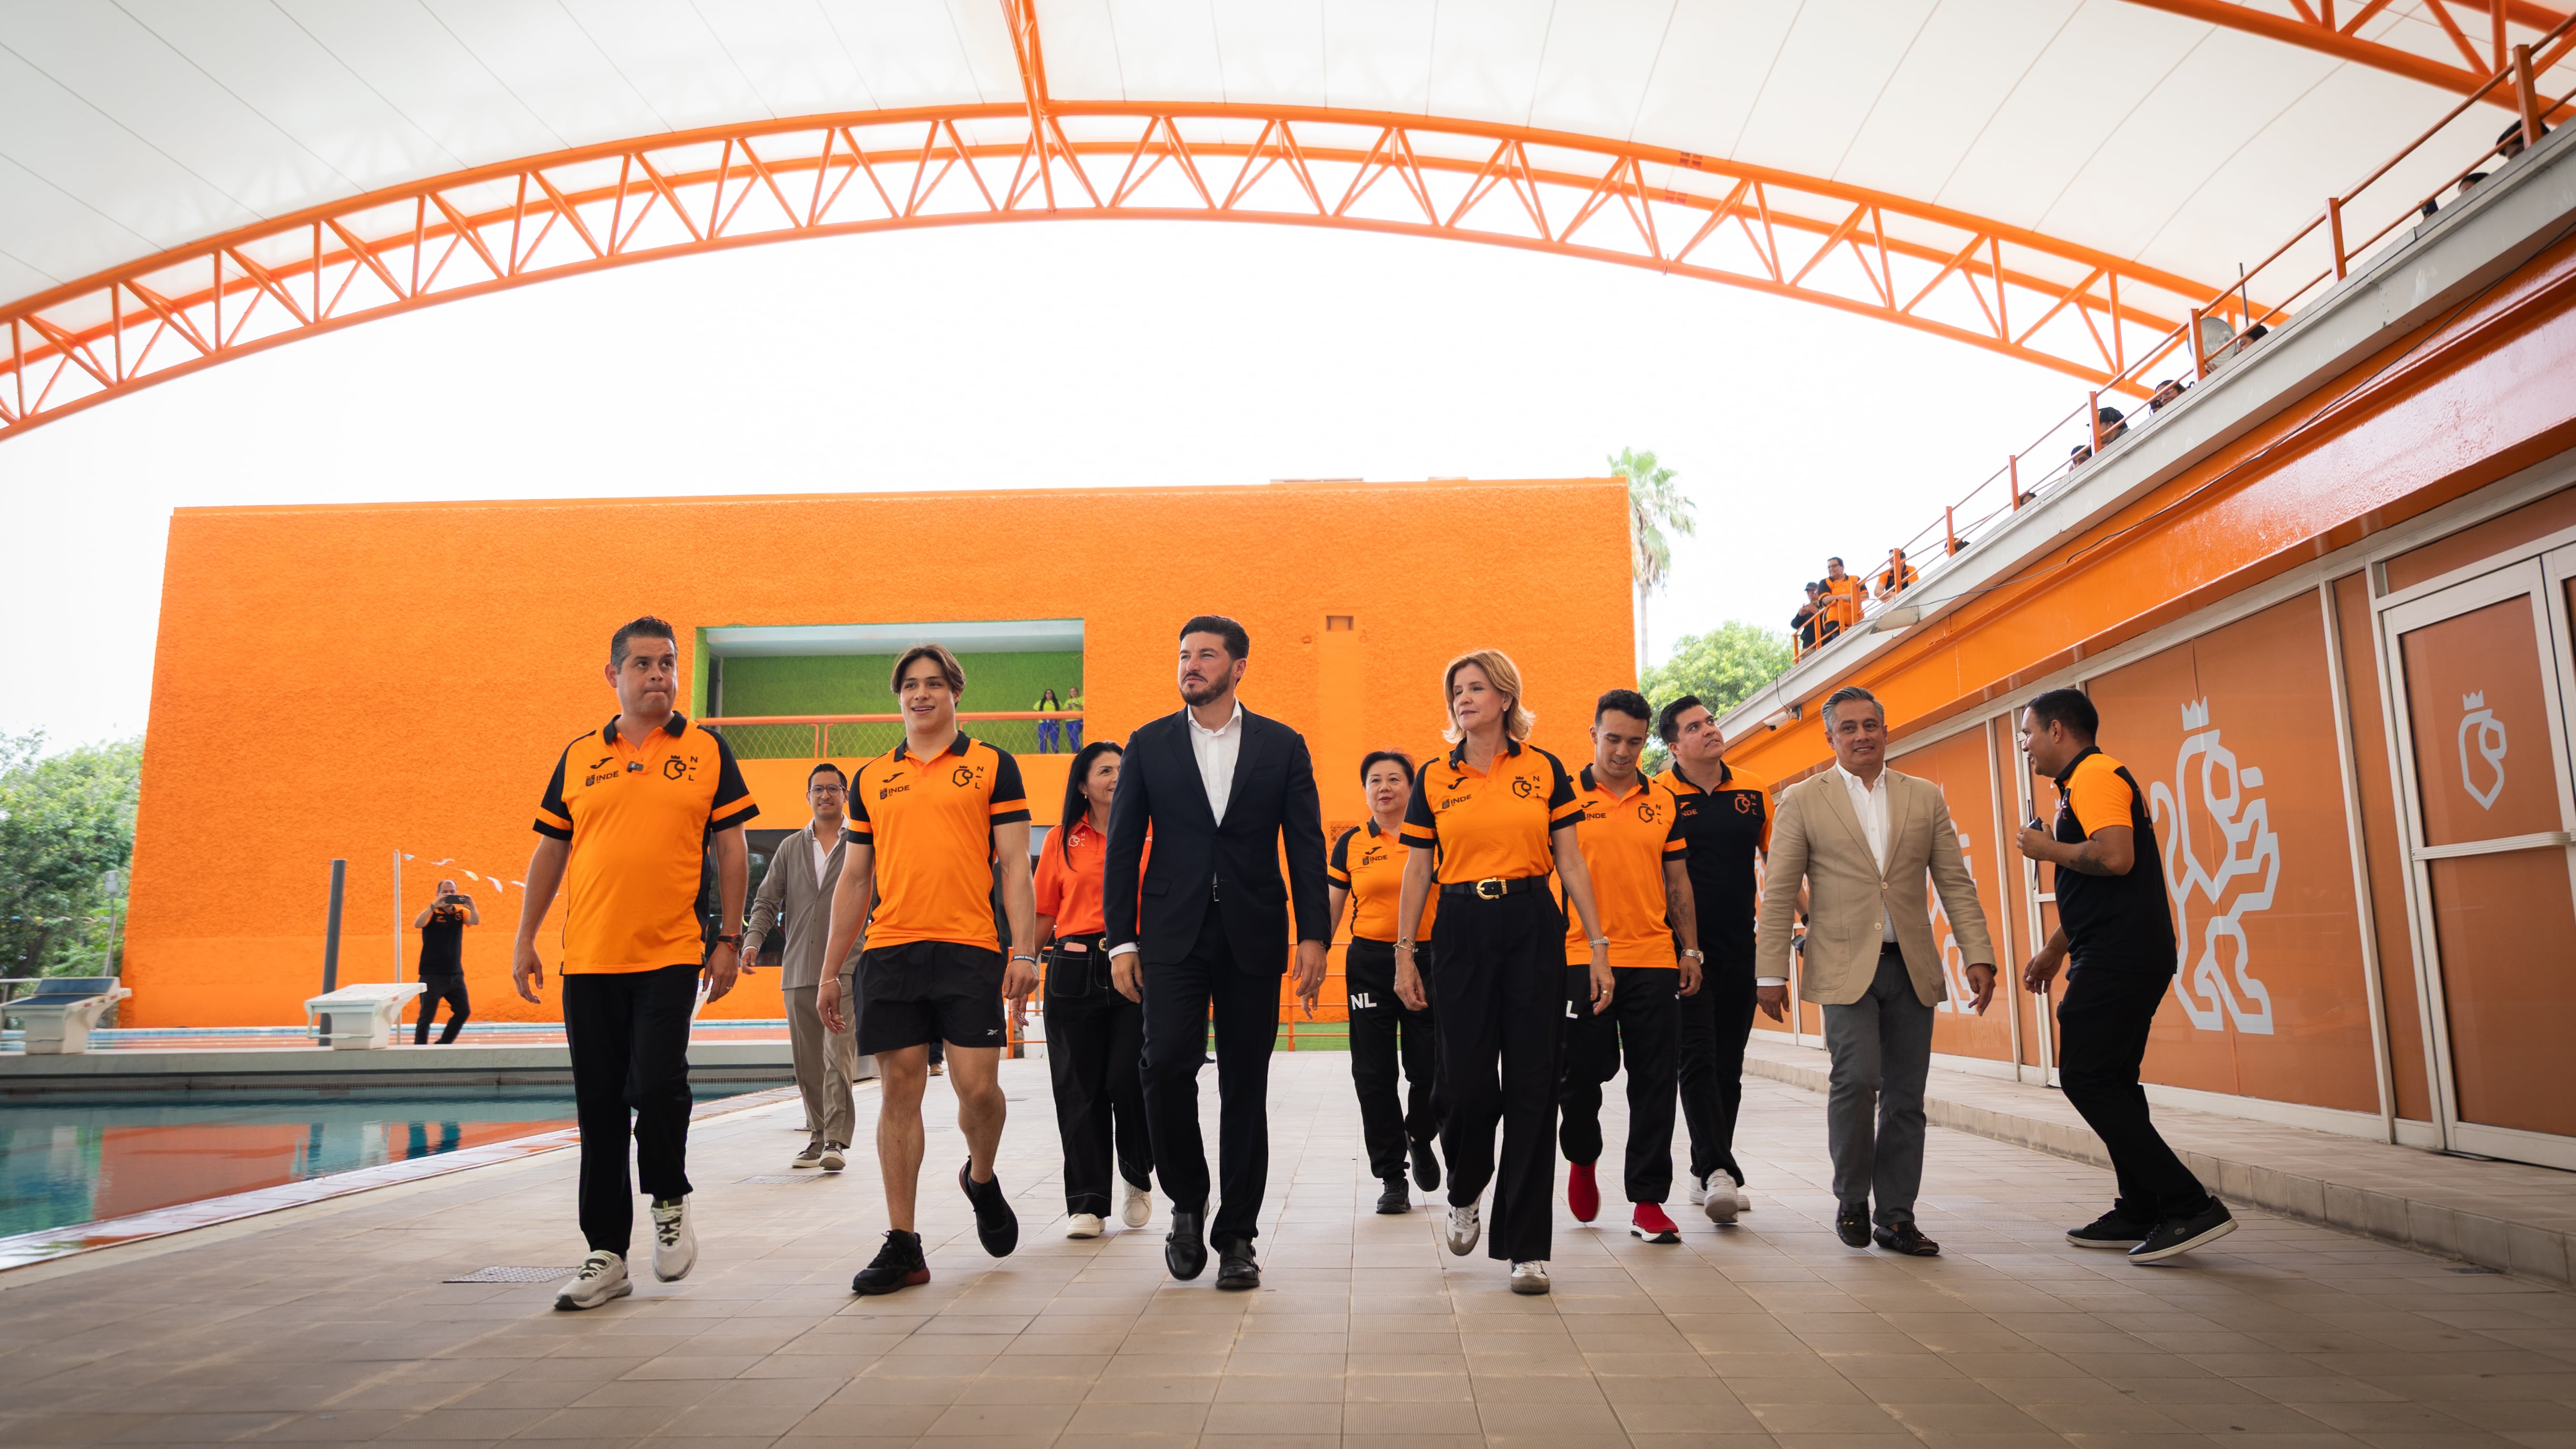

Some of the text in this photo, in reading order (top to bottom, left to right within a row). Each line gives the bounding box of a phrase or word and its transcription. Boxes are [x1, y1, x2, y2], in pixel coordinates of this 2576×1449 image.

[596, 770, 619, 783] INDE
[888, 785, 910, 796] INDE
[1451, 794, 1472, 806] INDE
[1370, 854, 1388, 864] INDE
[1350, 992, 1377, 1010] NL
[1566, 1000, 1579, 1020] L
